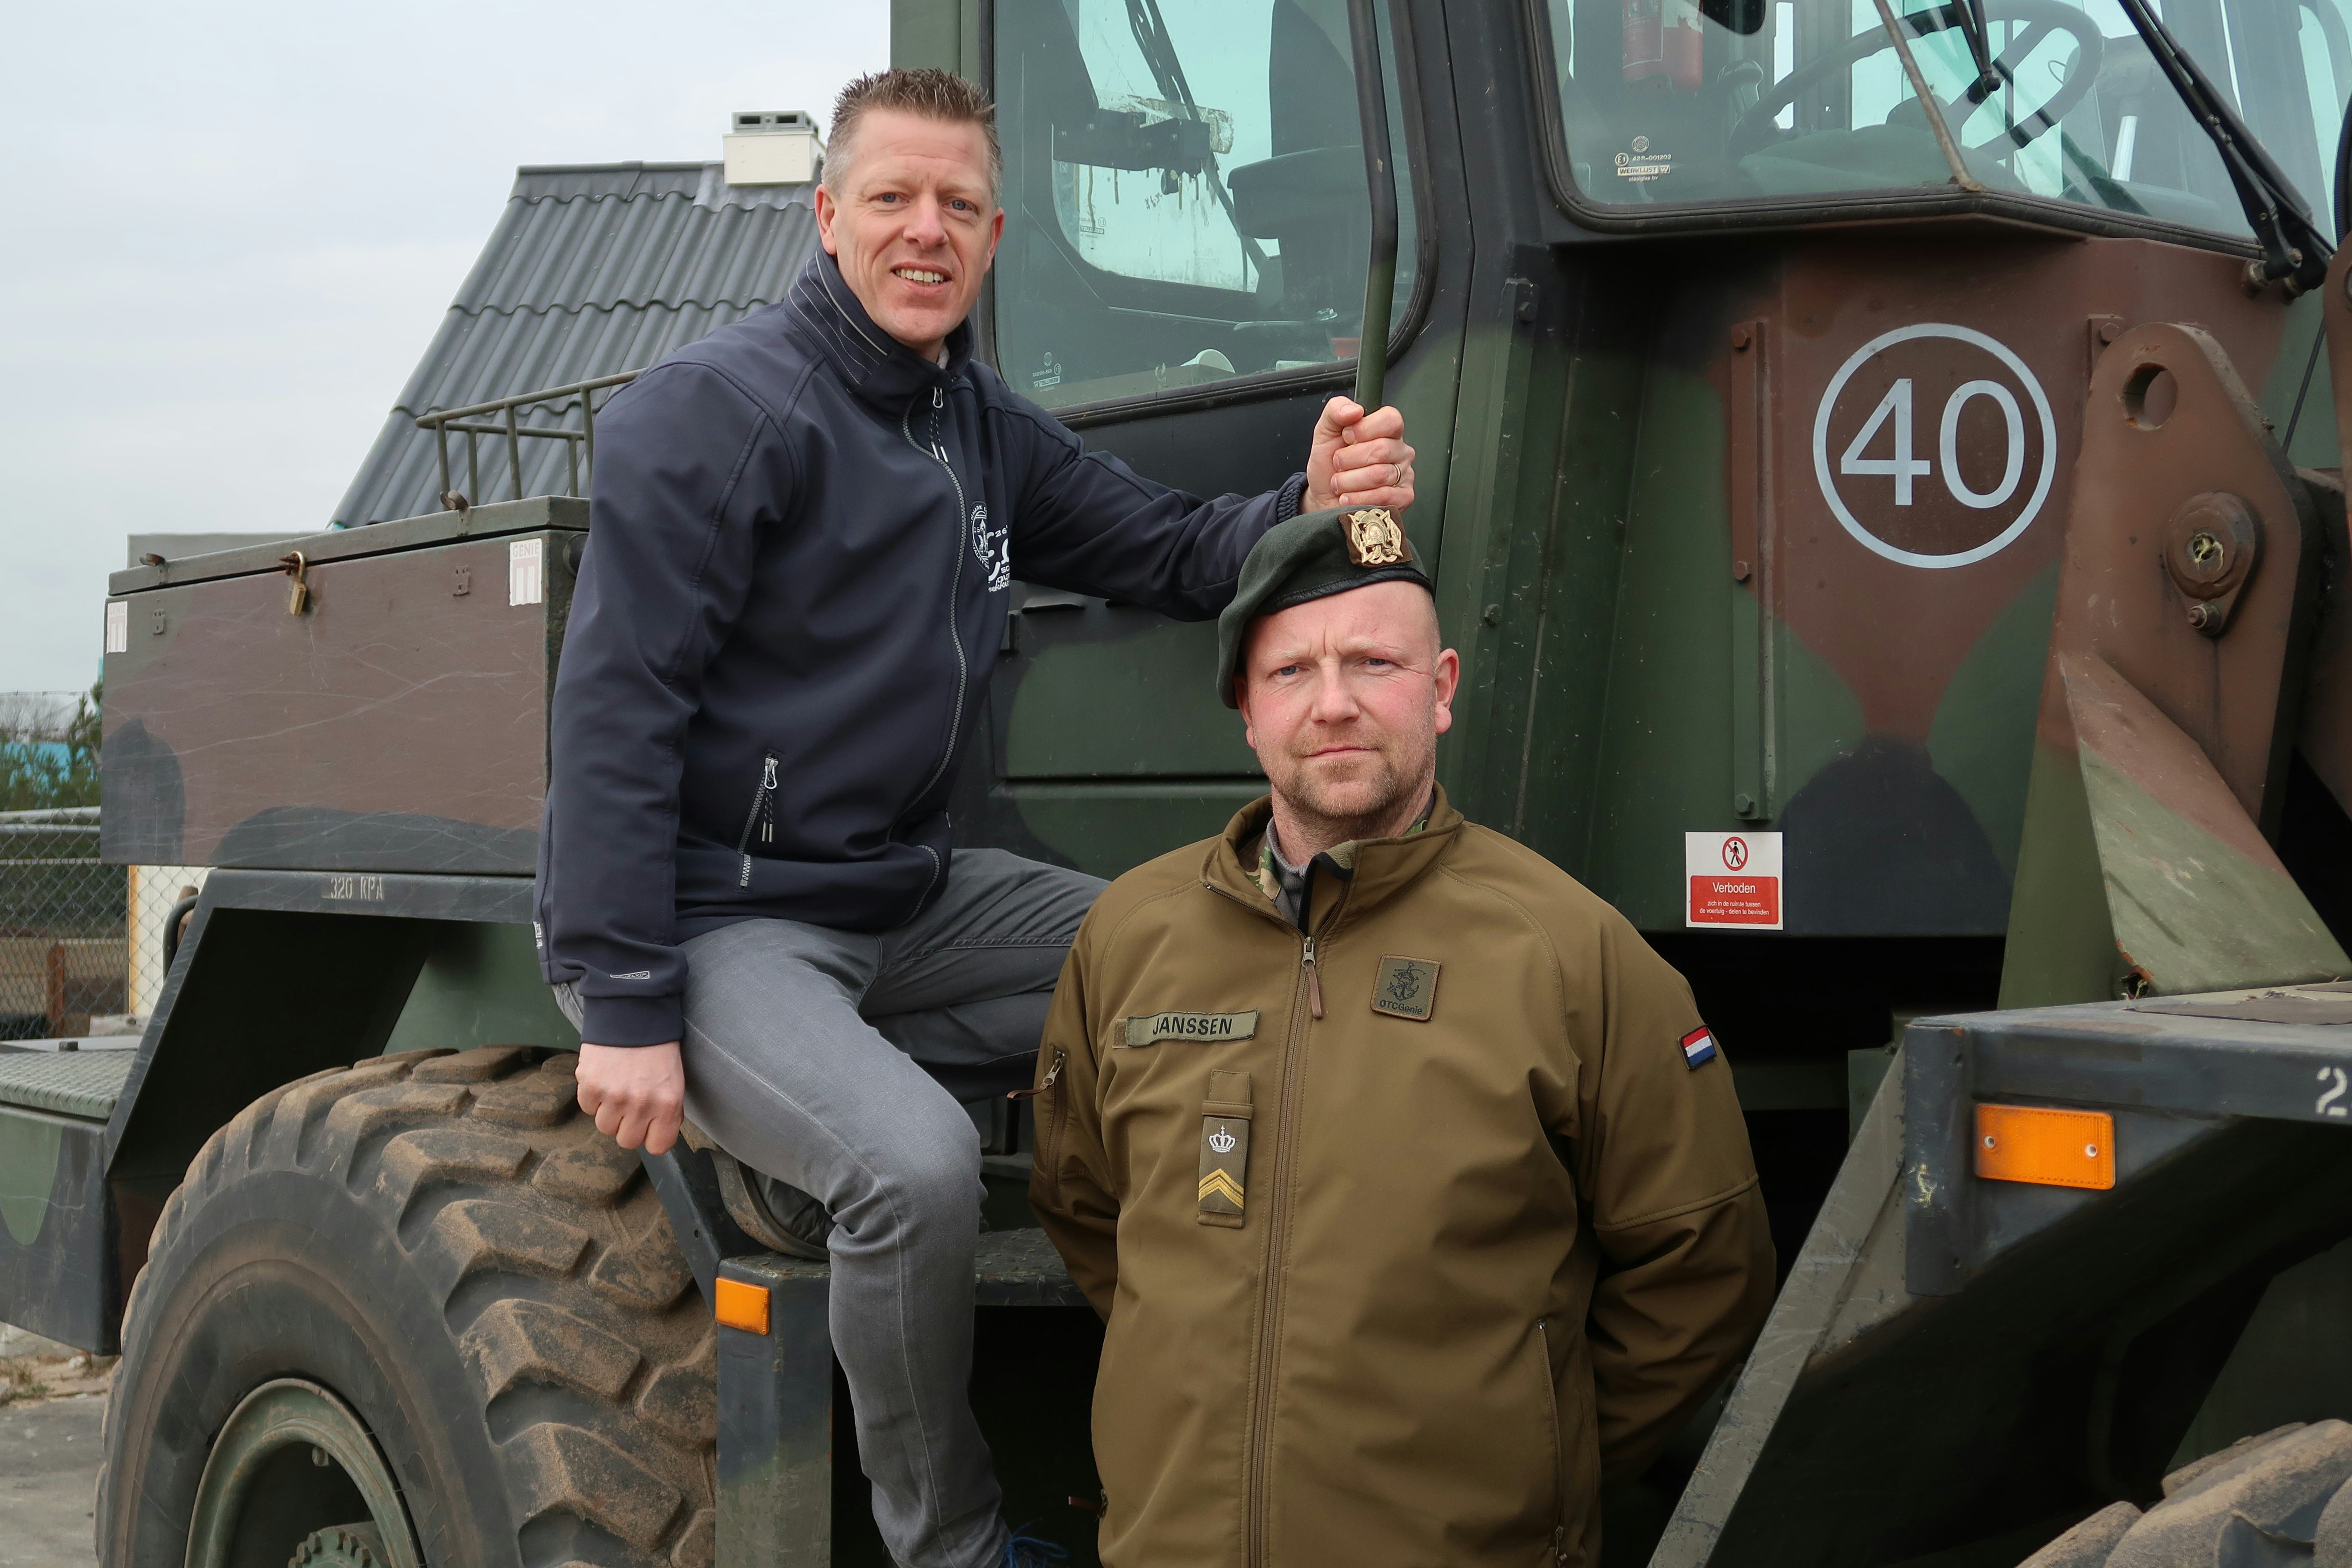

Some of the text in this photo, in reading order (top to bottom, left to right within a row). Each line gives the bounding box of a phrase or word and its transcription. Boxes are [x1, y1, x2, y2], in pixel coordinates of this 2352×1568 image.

[1841, 378, 2024, 508] 40
[513, 543, 540, 557] GENIE
[330, 877, 352, 899] 320
[1712, 882, 1755, 893] Verboden
[1380, 1000, 1422, 1014] OTCGenie
[1152, 1017, 1232, 1035] JANSSEN
[2315, 1066, 2352, 1116] 2
